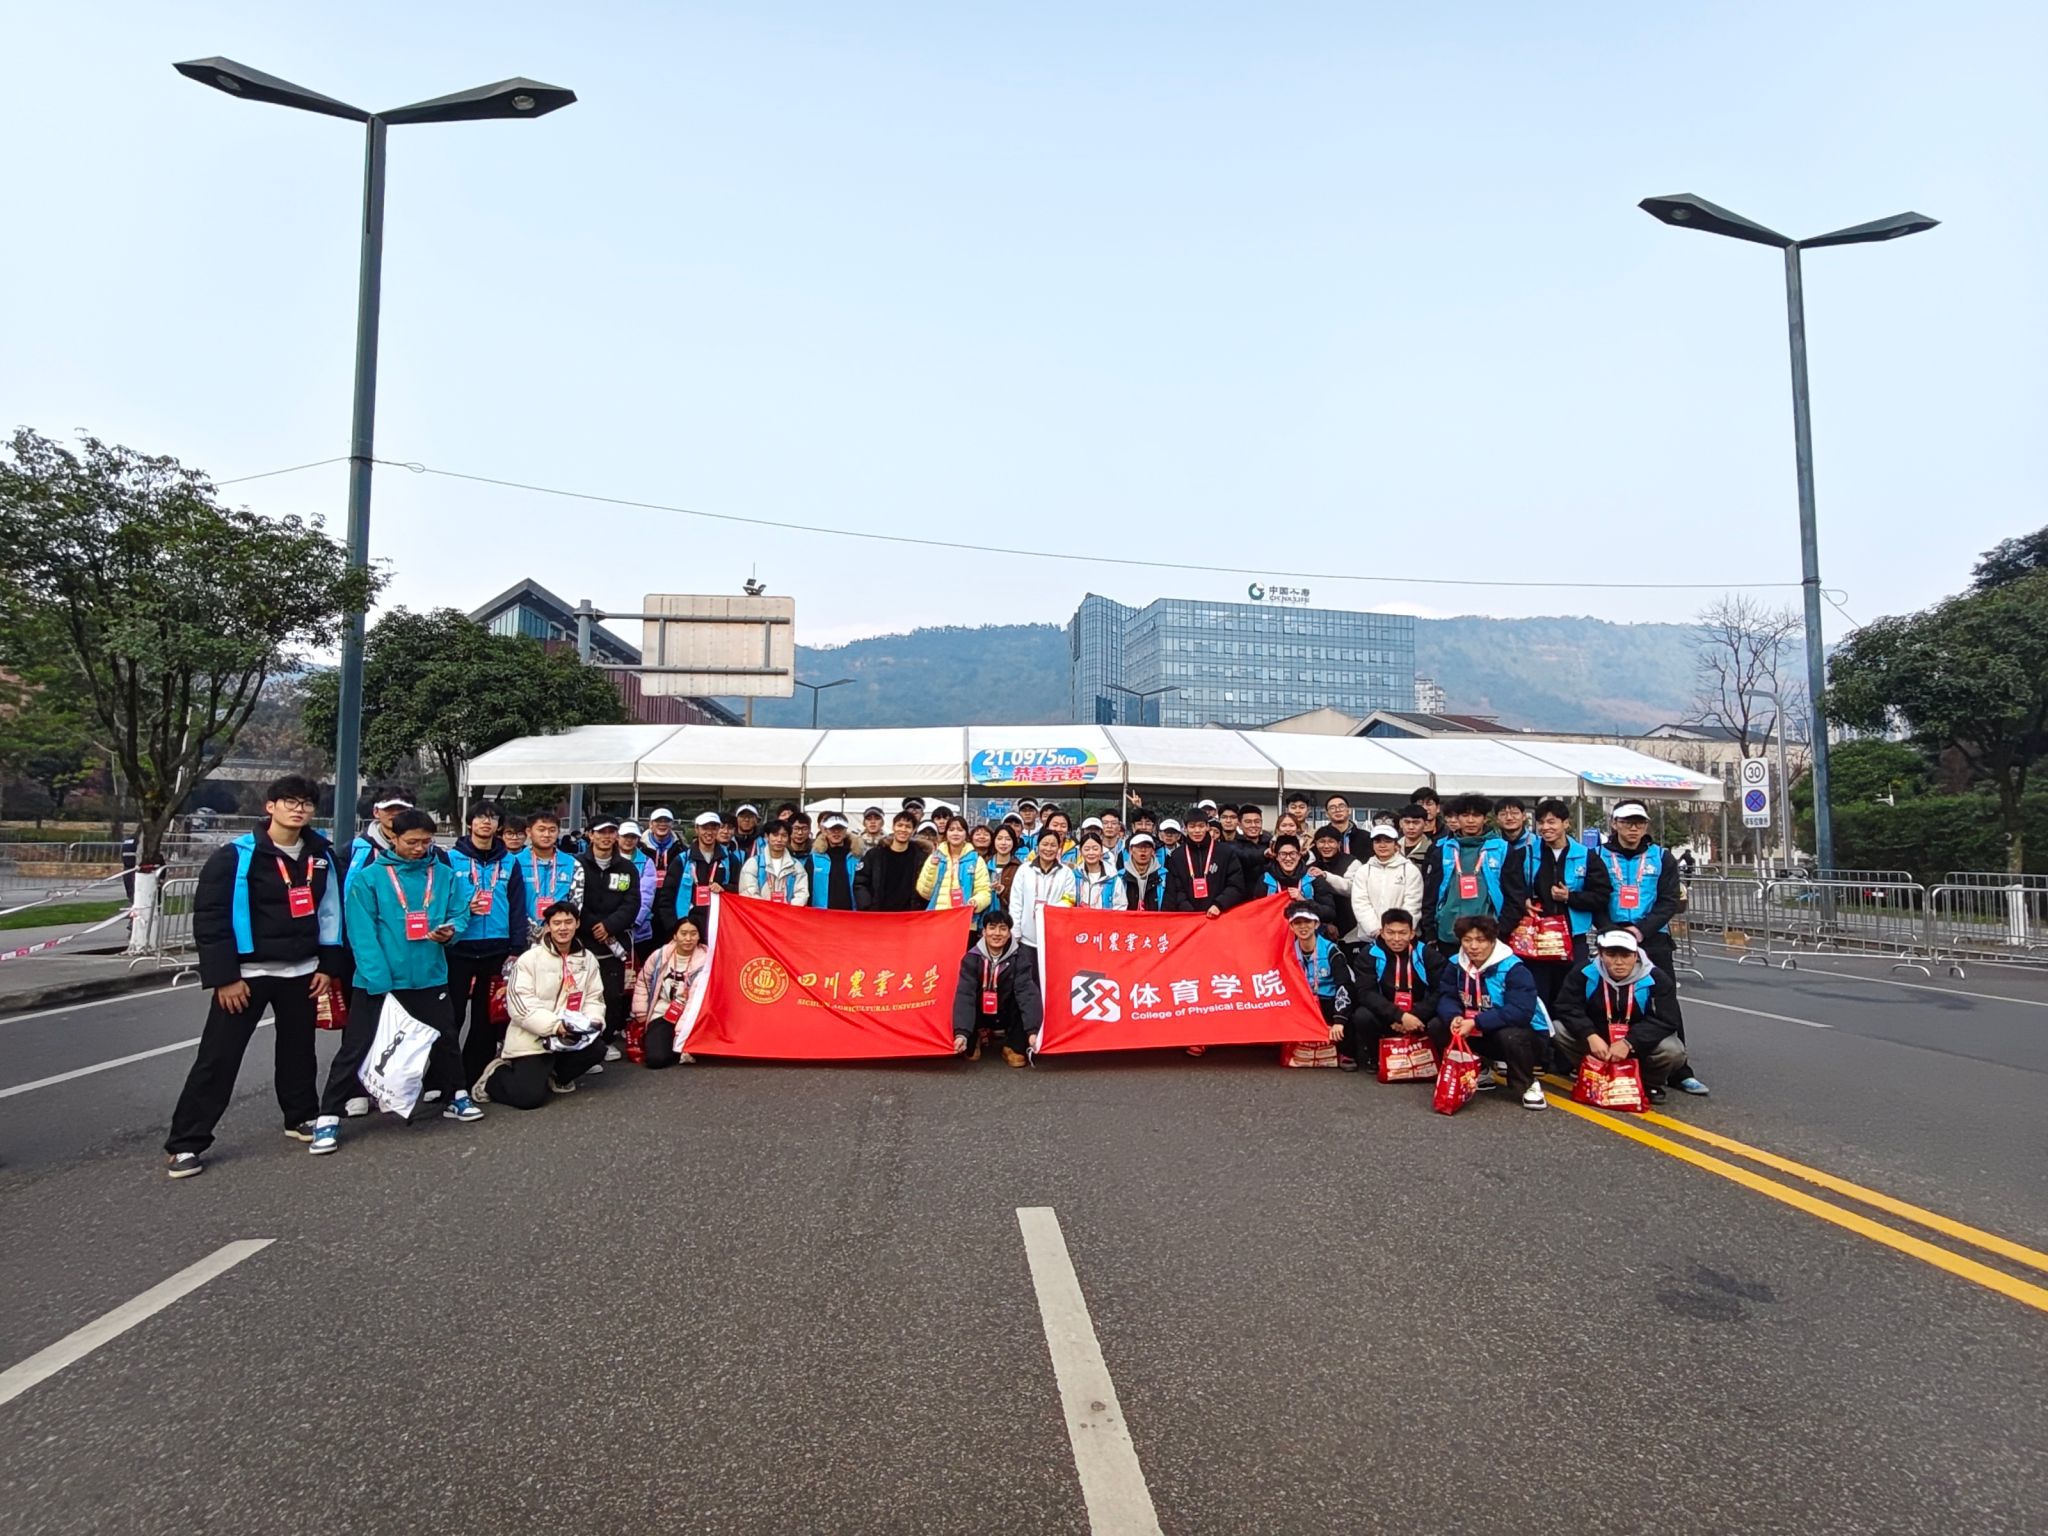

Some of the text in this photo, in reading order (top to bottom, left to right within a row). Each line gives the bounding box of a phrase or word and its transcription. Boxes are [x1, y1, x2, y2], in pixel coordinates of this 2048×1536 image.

[982, 749, 1077, 766] 21.0975Km
[1014, 766, 1085, 782] 恭喜完赛
[1748, 766, 1761, 779] 30
[1129, 969, 1287, 1009] 体育学院
[892, 998, 937, 1011] UNIVERSITY
[1131, 997, 1291, 1021] College of Physical Education
